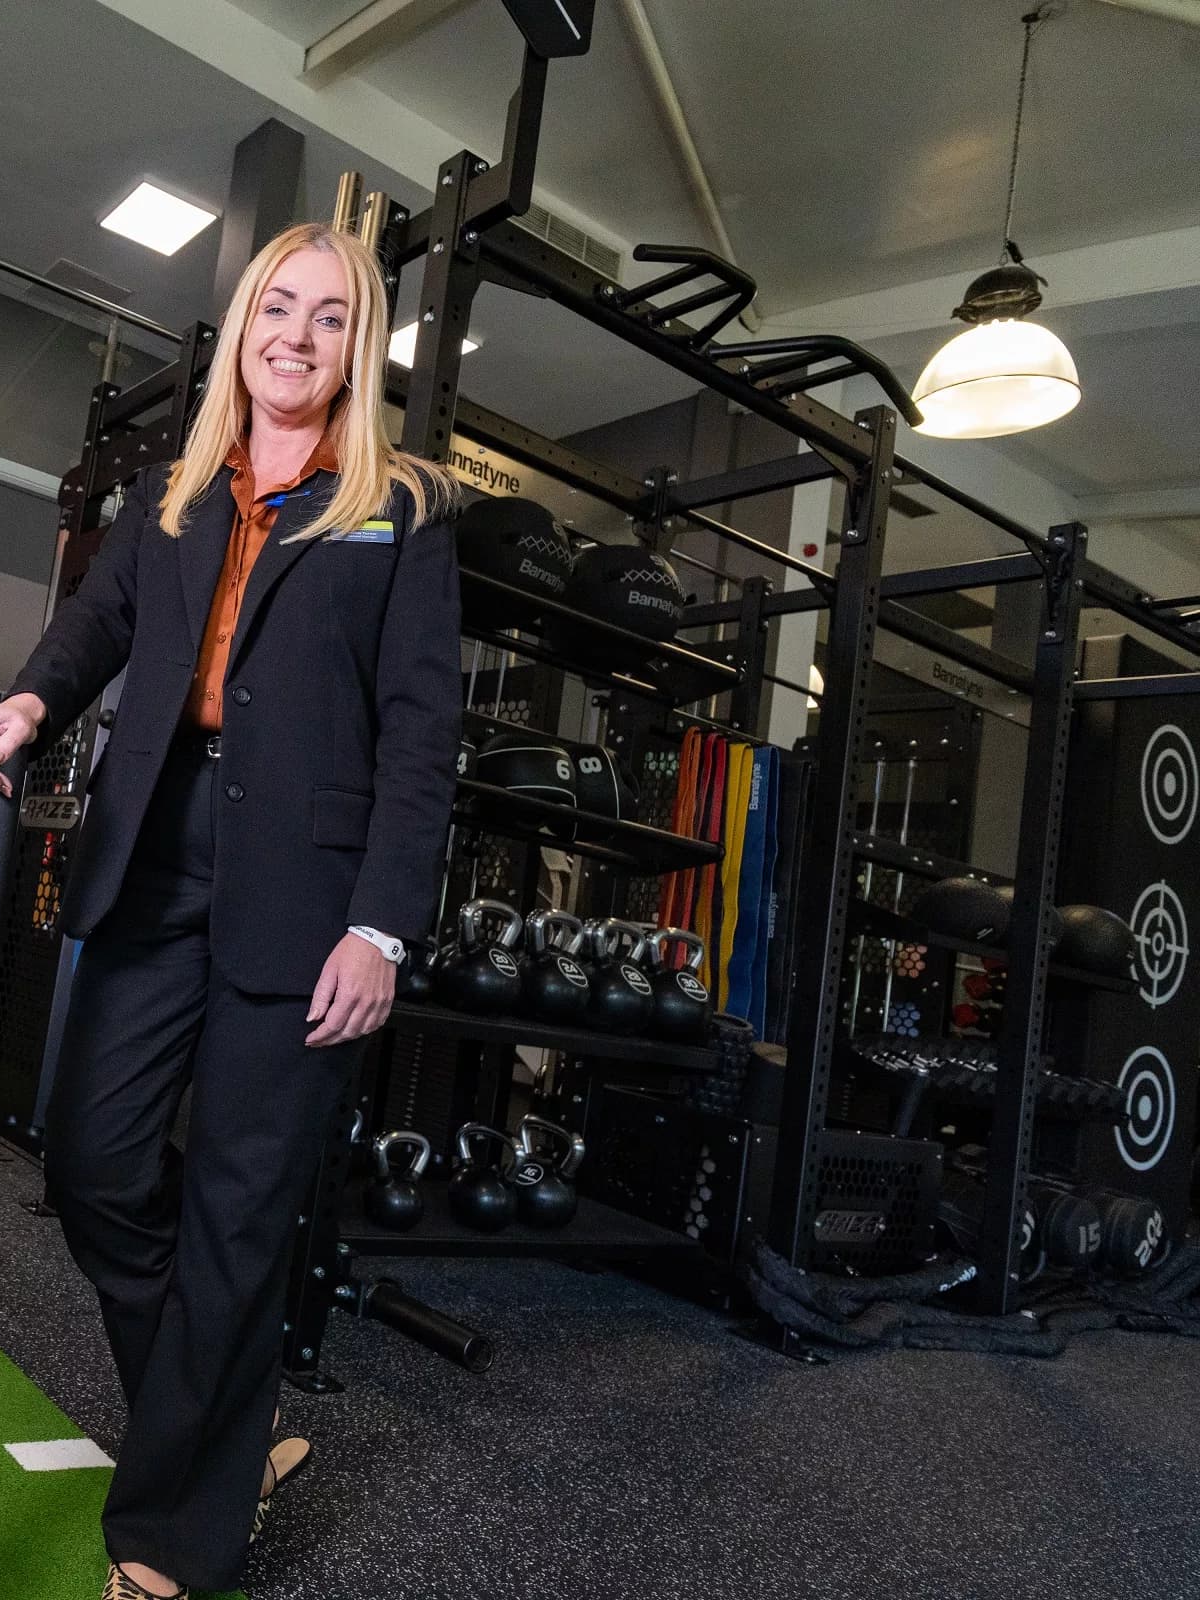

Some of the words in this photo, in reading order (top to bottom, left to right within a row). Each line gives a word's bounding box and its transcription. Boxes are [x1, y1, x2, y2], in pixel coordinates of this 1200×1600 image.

[456, 752, 467, 774] 4
[556, 759, 570, 780] 6
[578, 756, 602, 774] 8
[1078, 1221, 1100, 1254] 15
